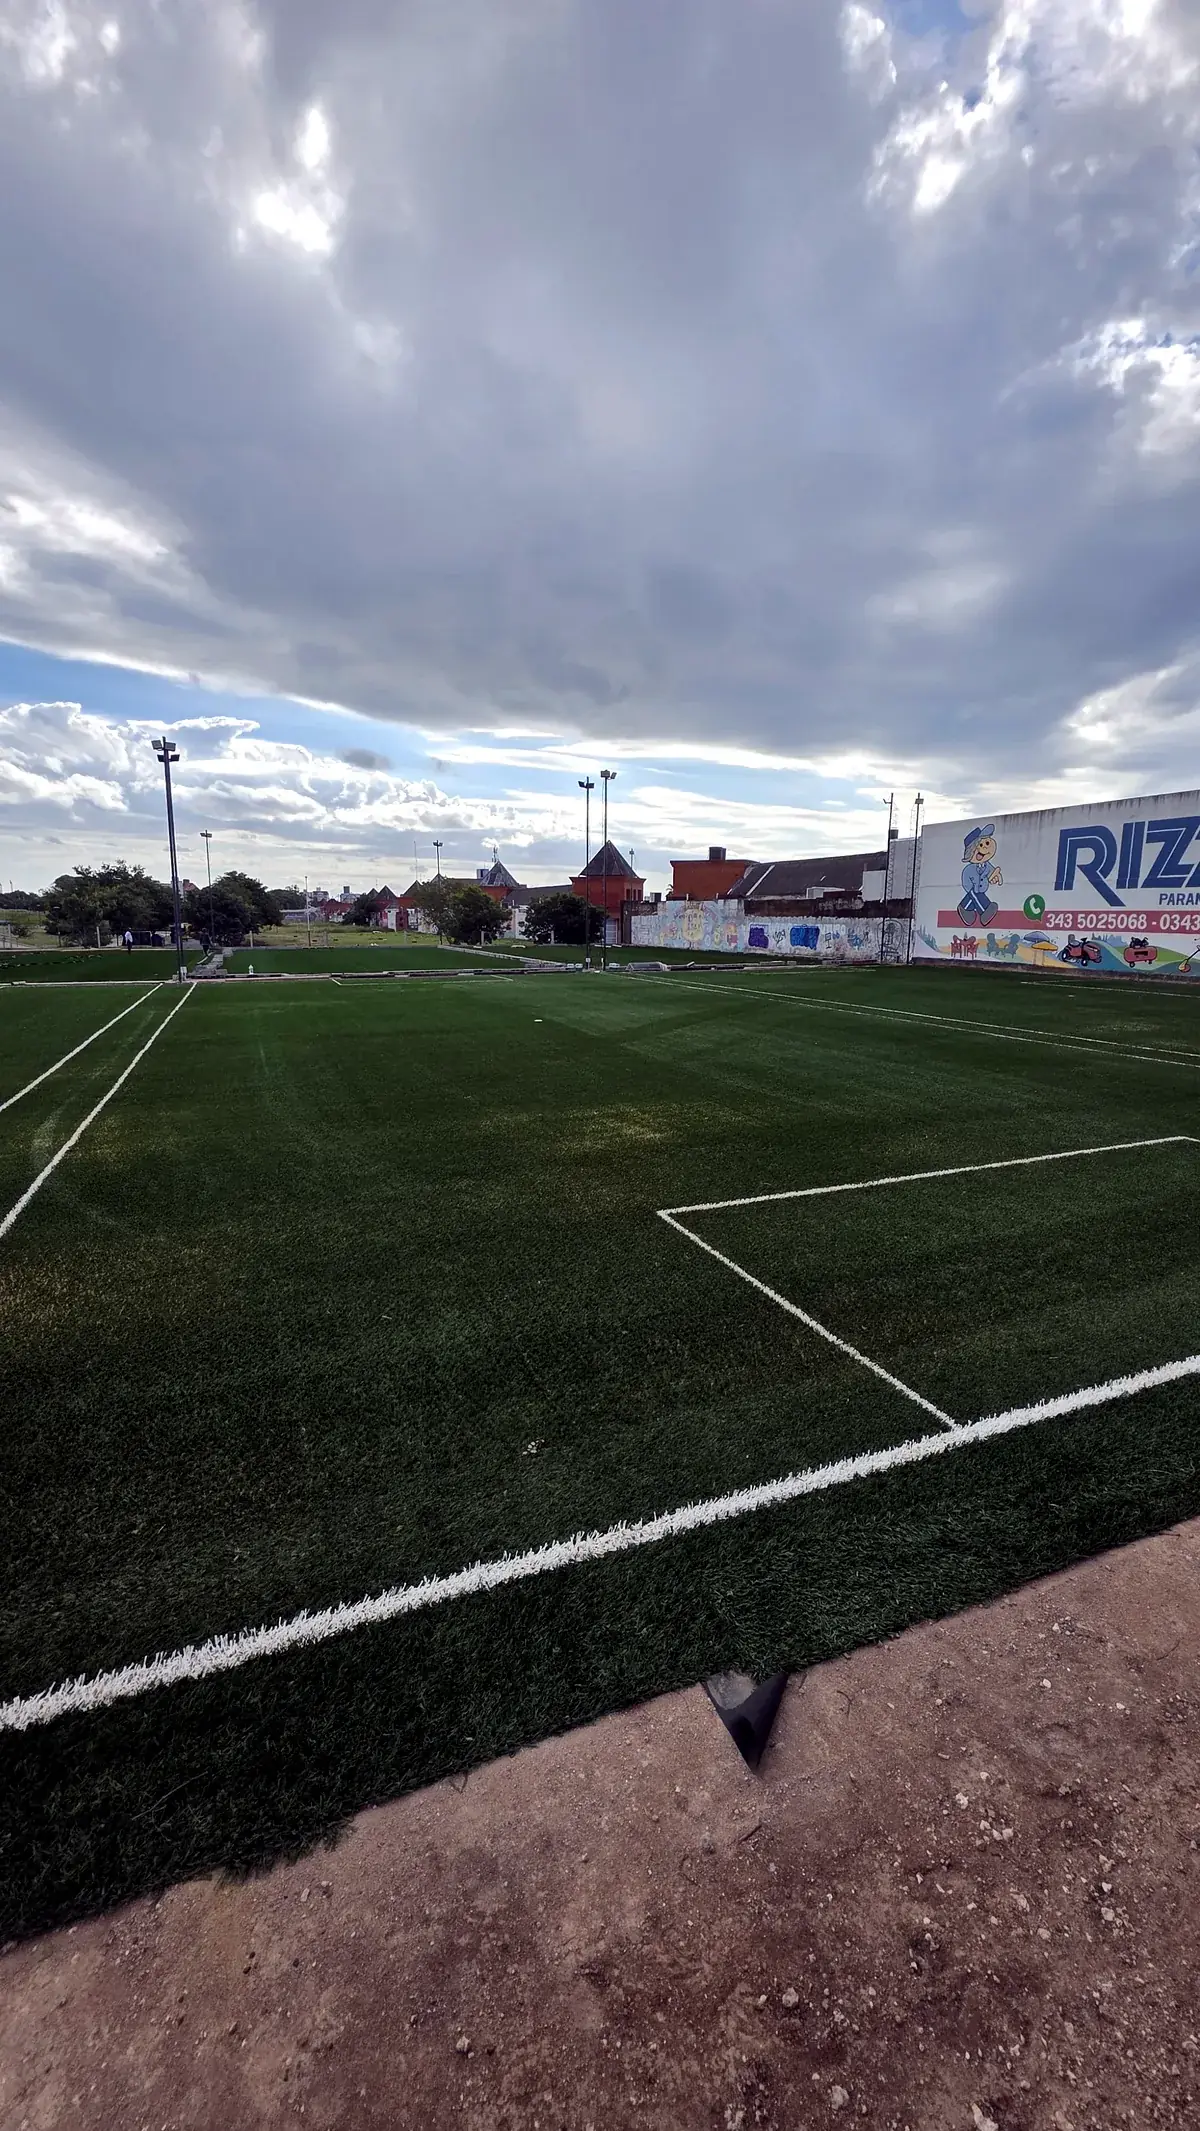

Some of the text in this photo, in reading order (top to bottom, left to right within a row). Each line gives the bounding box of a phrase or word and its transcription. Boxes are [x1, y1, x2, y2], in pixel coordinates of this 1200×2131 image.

[1054, 815, 1200, 907] RIZ
[1046, 913, 1073, 928] 343
[1077, 913, 1147, 930] 5025068
[1159, 913, 1200, 931] 0343
